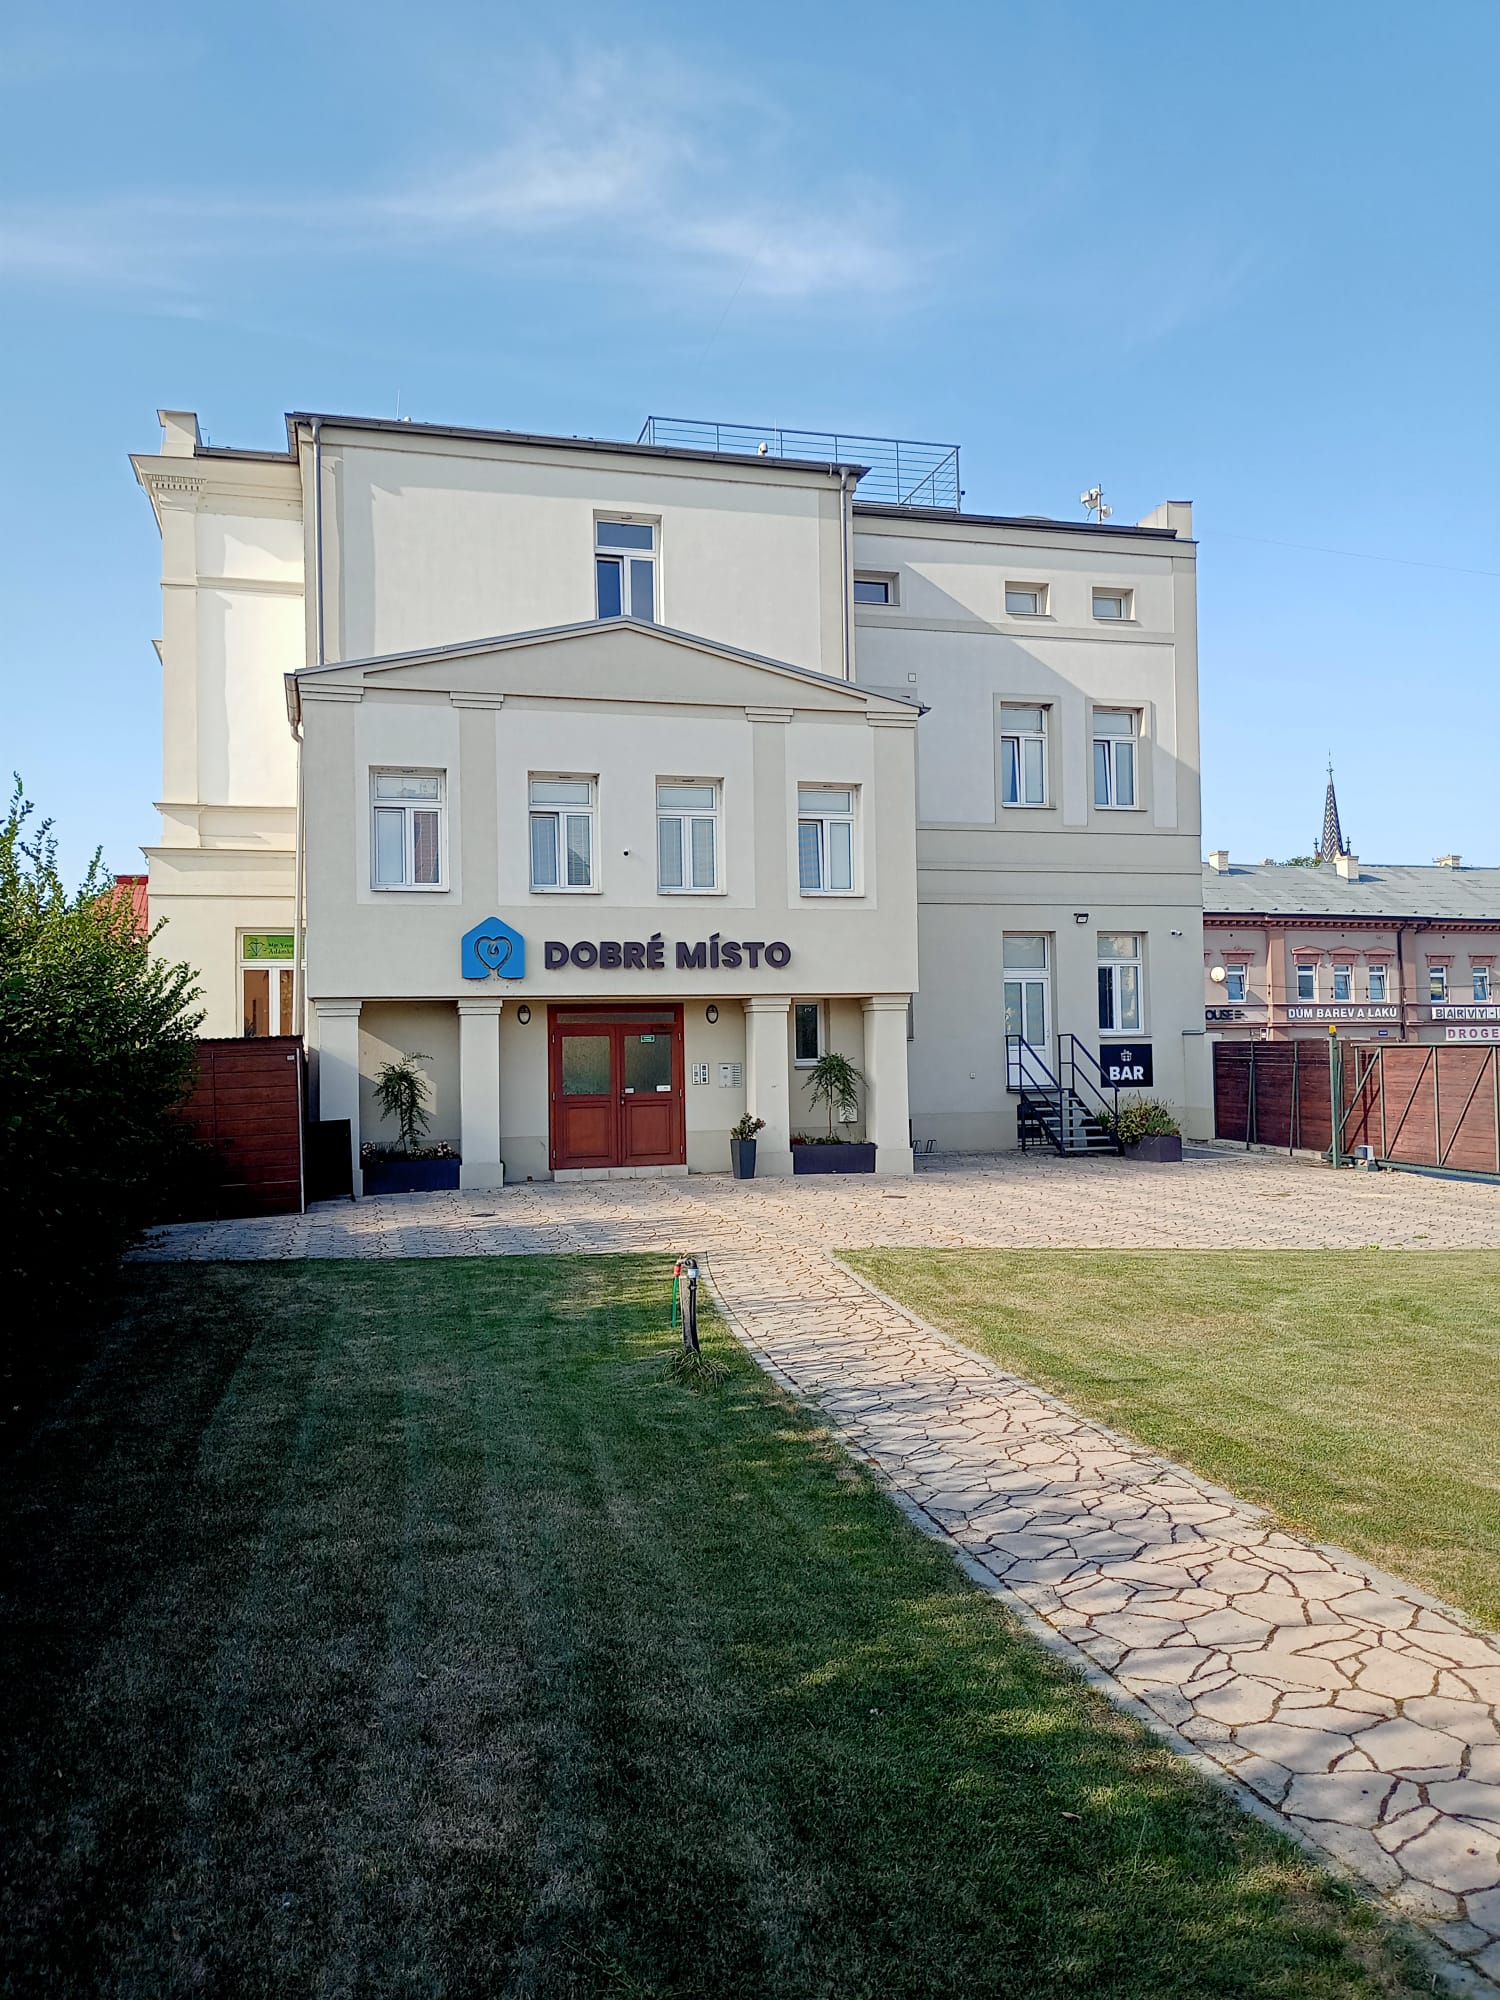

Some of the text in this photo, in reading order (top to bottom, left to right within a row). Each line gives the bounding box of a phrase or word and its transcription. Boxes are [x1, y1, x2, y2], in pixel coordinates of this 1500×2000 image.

[544, 932, 792, 969] DOBRÉ MÍSTO
[1288, 1005, 1397, 1018] DŮM BAREV A LAKŮ
[1435, 1008, 1500, 1018] BARVY-
[1447, 1028, 1499, 1039] DROGE
[1109, 1065, 1144, 1081] BAR
